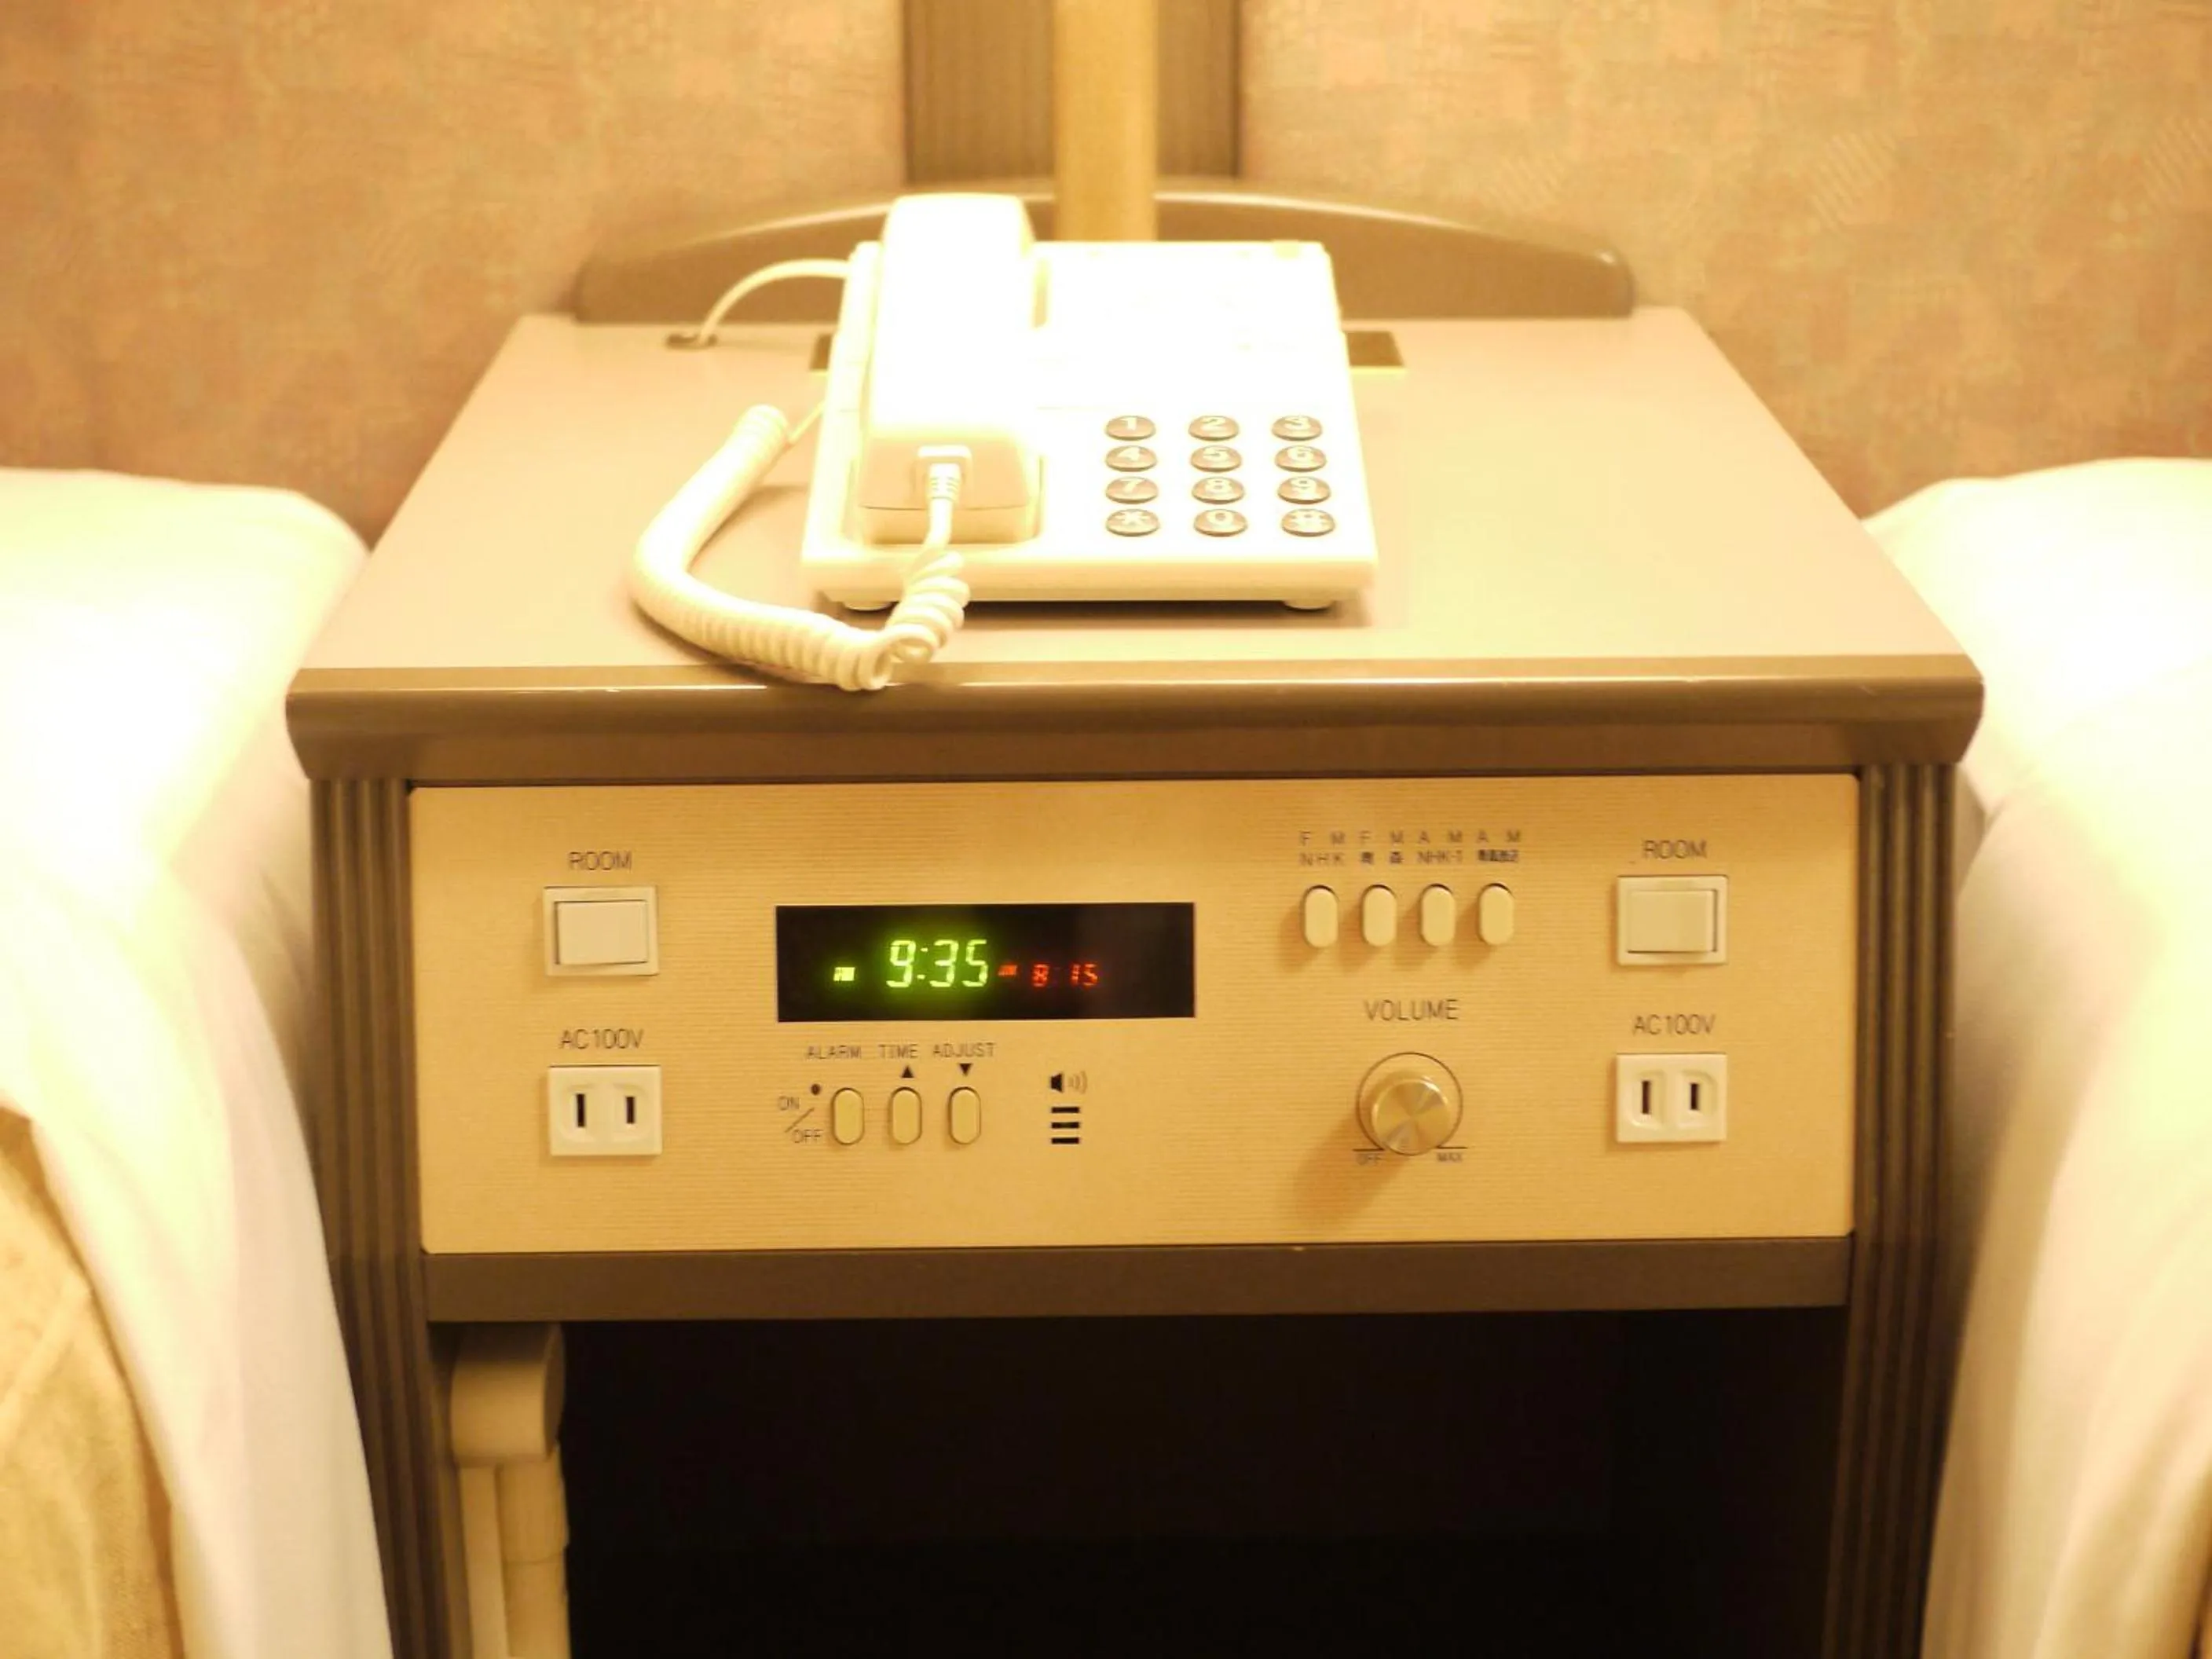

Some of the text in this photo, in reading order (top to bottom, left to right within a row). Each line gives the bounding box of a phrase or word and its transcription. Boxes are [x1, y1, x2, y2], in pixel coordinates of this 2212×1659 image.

[1202, 416, 1226, 431] 2
[1284, 416, 1310, 431] 3
[1203, 446, 1229, 462] 5
[1287, 446, 1313, 462] 6
[1205, 478, 1232, 494] 8
[1290, 478, 1317, 495] 9
[1206, 511, 1233, 528] 0
[1642, 840, 1708, 860] ROOM
[569, 851, 632, 870] ROOM
[886, 939, 988, 988] 9:35
[1364, 999, 1459, 1021] VOLUME
[1632, 1014, 1716, 1035] AC100V
[558, 1029, 646, 1049] AC100V
[806, 1046, 862, 1060] ALARM
[878, 1042, 996, 1059] TIME ADJUST
[778, 1096, 800, 1111] ON
[791, 1129, 824, 1144] OFF
